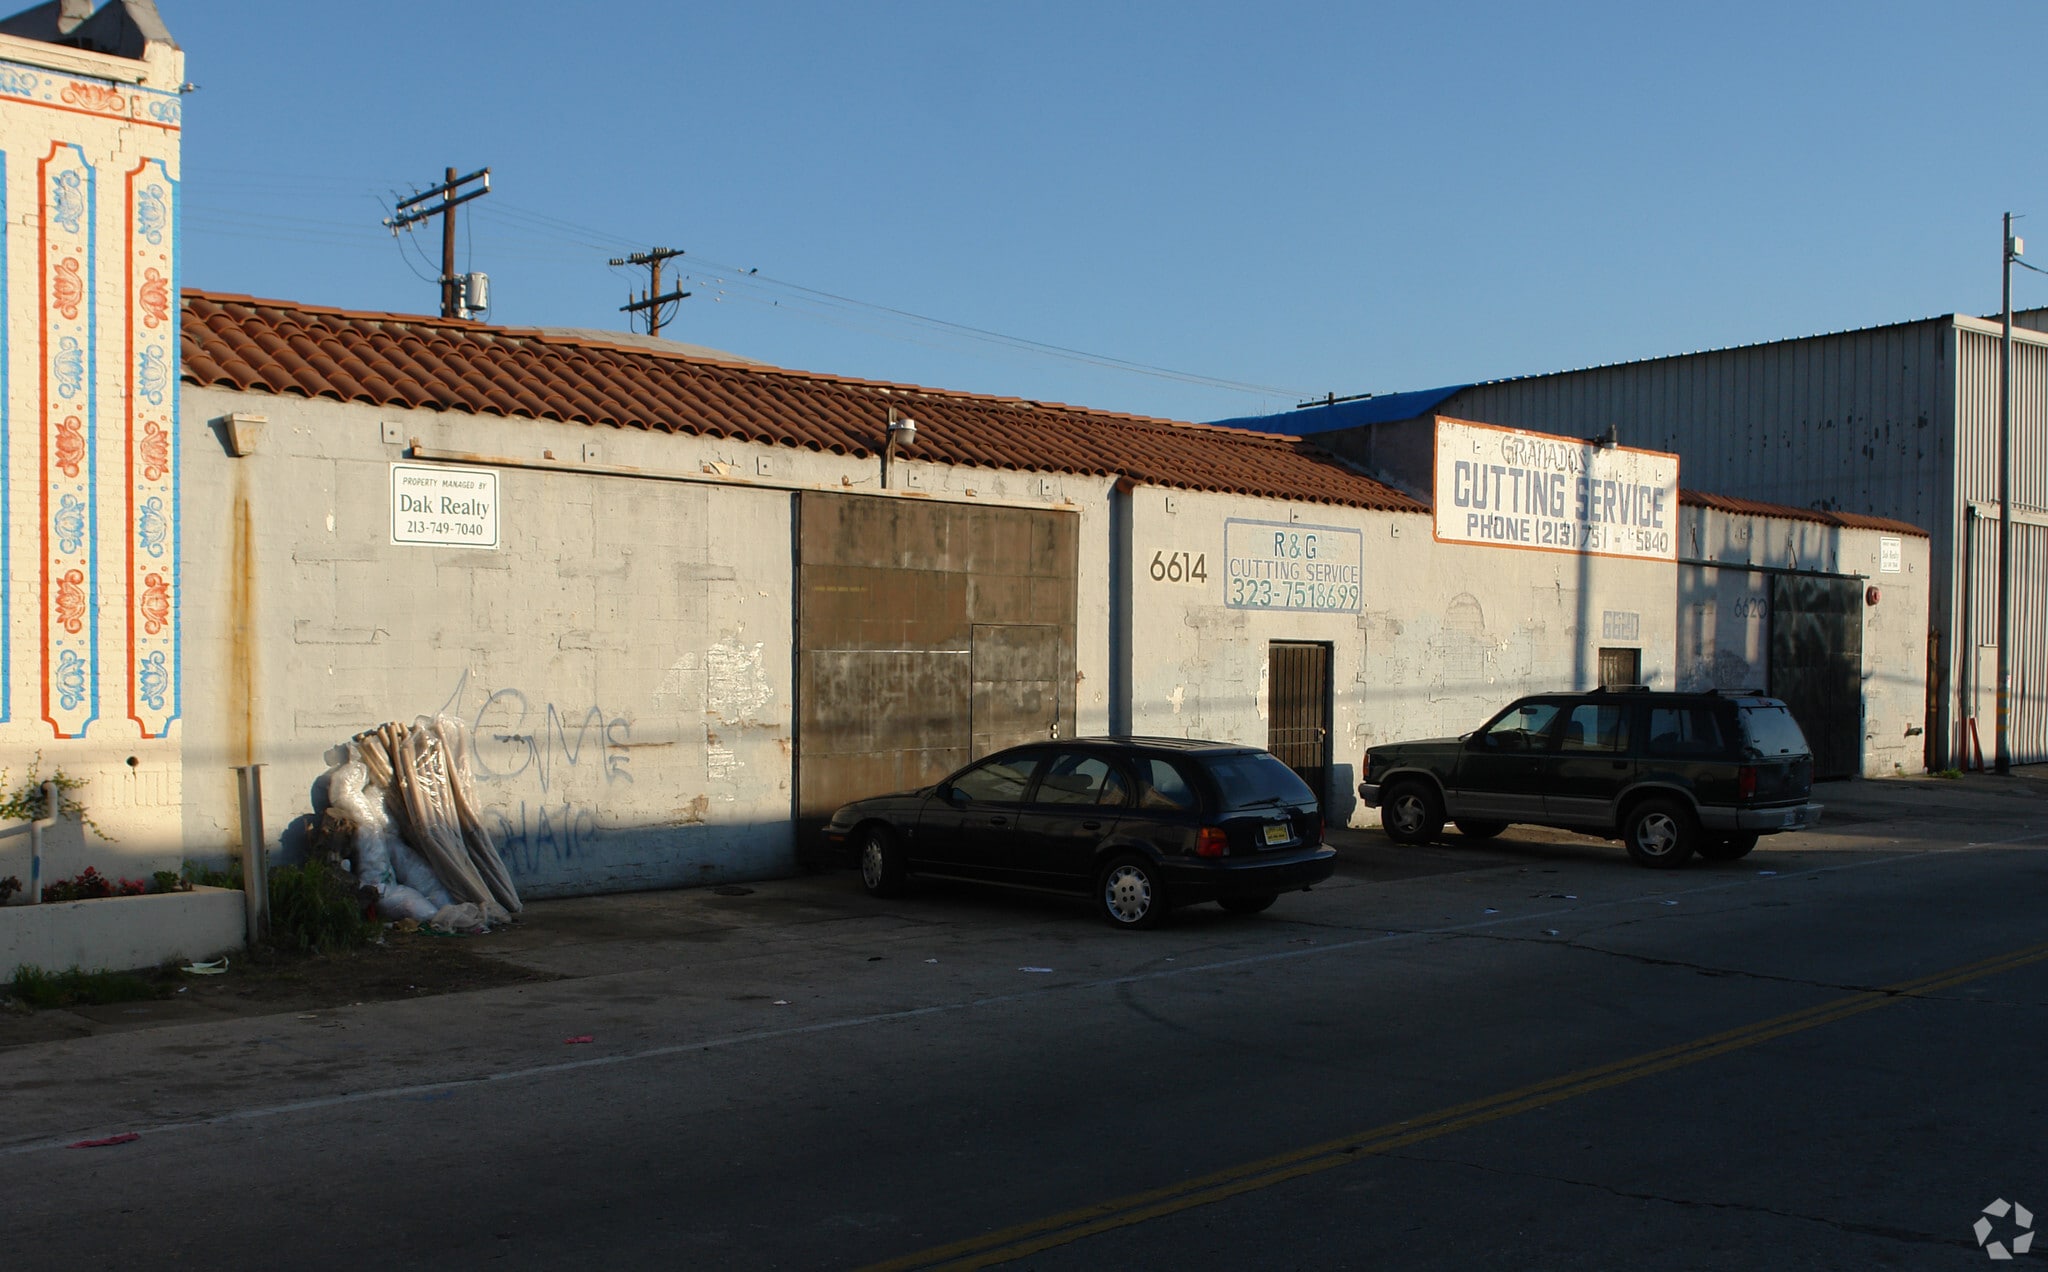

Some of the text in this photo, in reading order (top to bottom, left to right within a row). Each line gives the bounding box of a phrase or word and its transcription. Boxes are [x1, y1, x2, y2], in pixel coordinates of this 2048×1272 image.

[402, 477, 487, 490] PROPERTY MANAGED BY
[1454, 460, 1665, 528] CUTTING SERVICE
[400, 494, 490, 520] Dak Realty
[407, 520, 483, 536] 213-749-7040
[1467, 513, 1530, 542] PHONE
[1535, 518, 1576, 548] (213)
[1636, 530, 1668, 553] 5840
[1150, 551, 1208, 584] 6614
[1230, 559, 1359, 584] CUTTING SERVICE
[1232, 578, 1359, 609] 323-7518699
[1735, 597, 1767, 619] 6620
